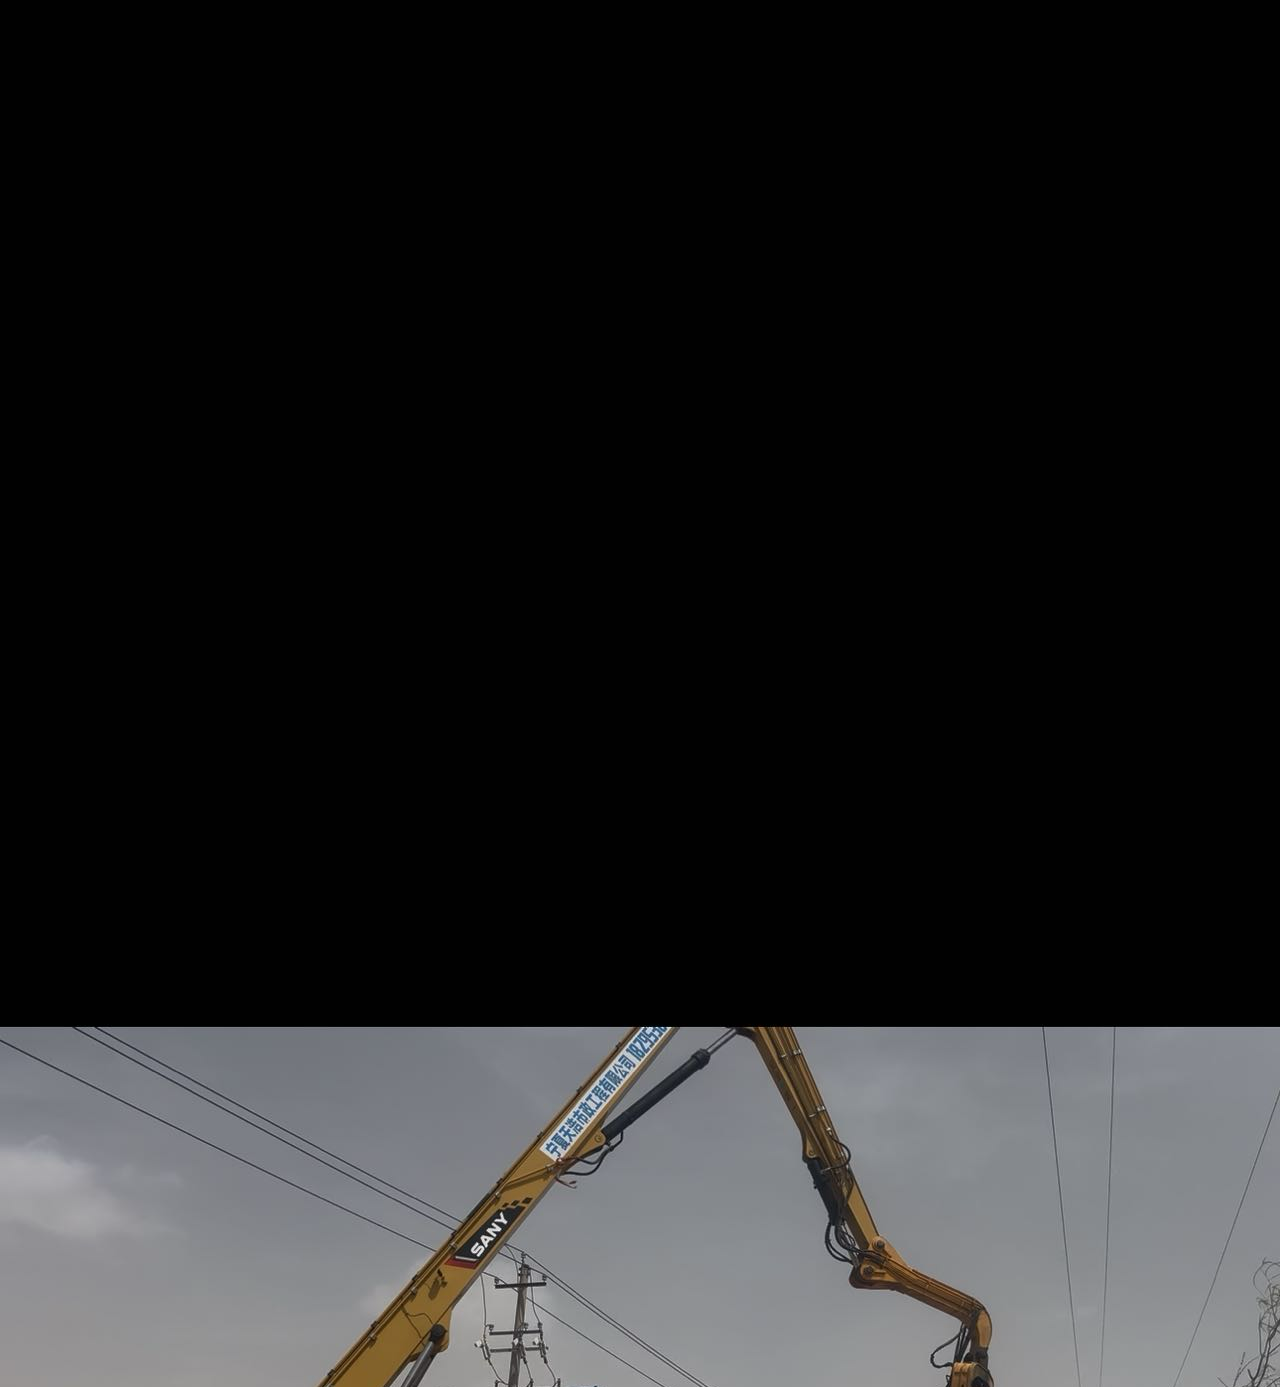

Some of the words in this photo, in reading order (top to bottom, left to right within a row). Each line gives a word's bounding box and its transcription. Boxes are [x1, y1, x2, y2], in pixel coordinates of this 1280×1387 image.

[545, 1055, 636, 1157] 宁夏天浩市政工程有限公司
[470, 1211, 508, 1257] SANY
